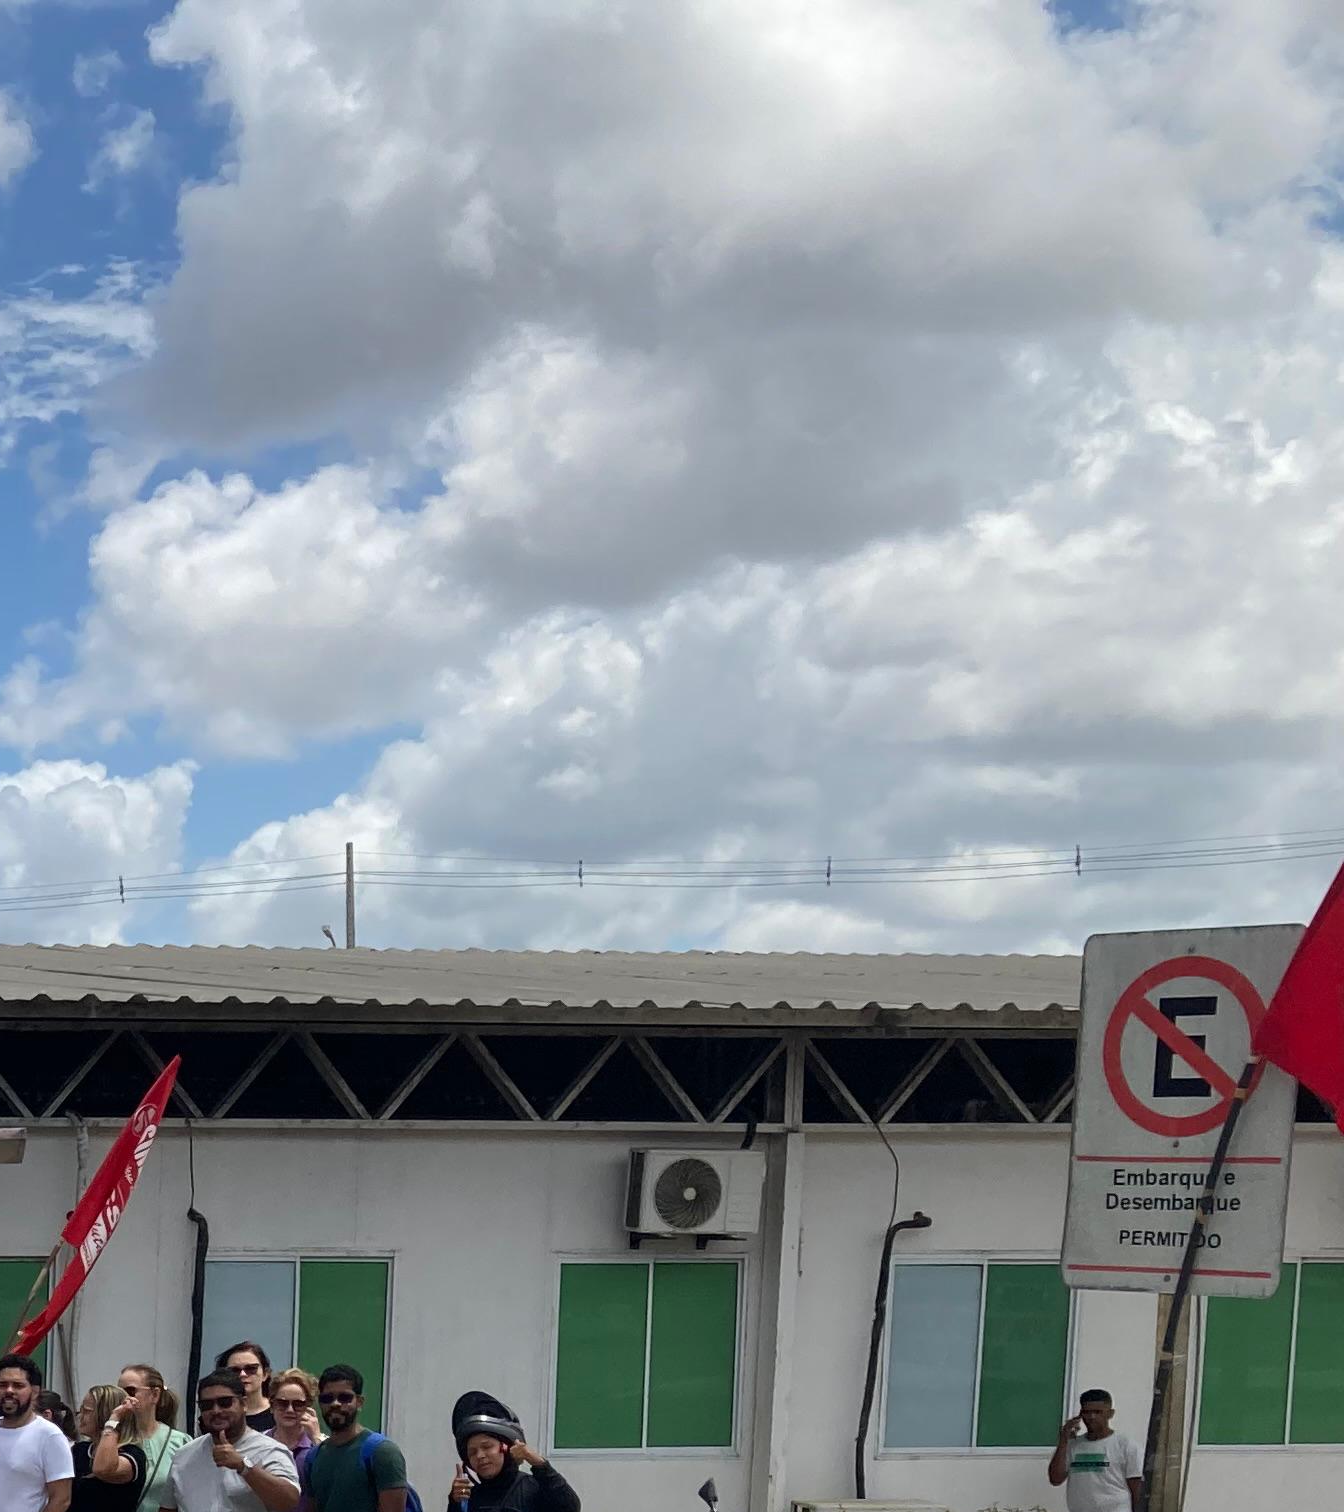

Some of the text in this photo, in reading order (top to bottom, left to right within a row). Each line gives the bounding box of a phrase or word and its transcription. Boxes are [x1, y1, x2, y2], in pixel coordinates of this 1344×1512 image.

[1153, 996, 1218, 1098] E
[1113, 1168, 1236, 1190] Embarqu e
[1119, 1230, 1222, 1249] PERMITDO
